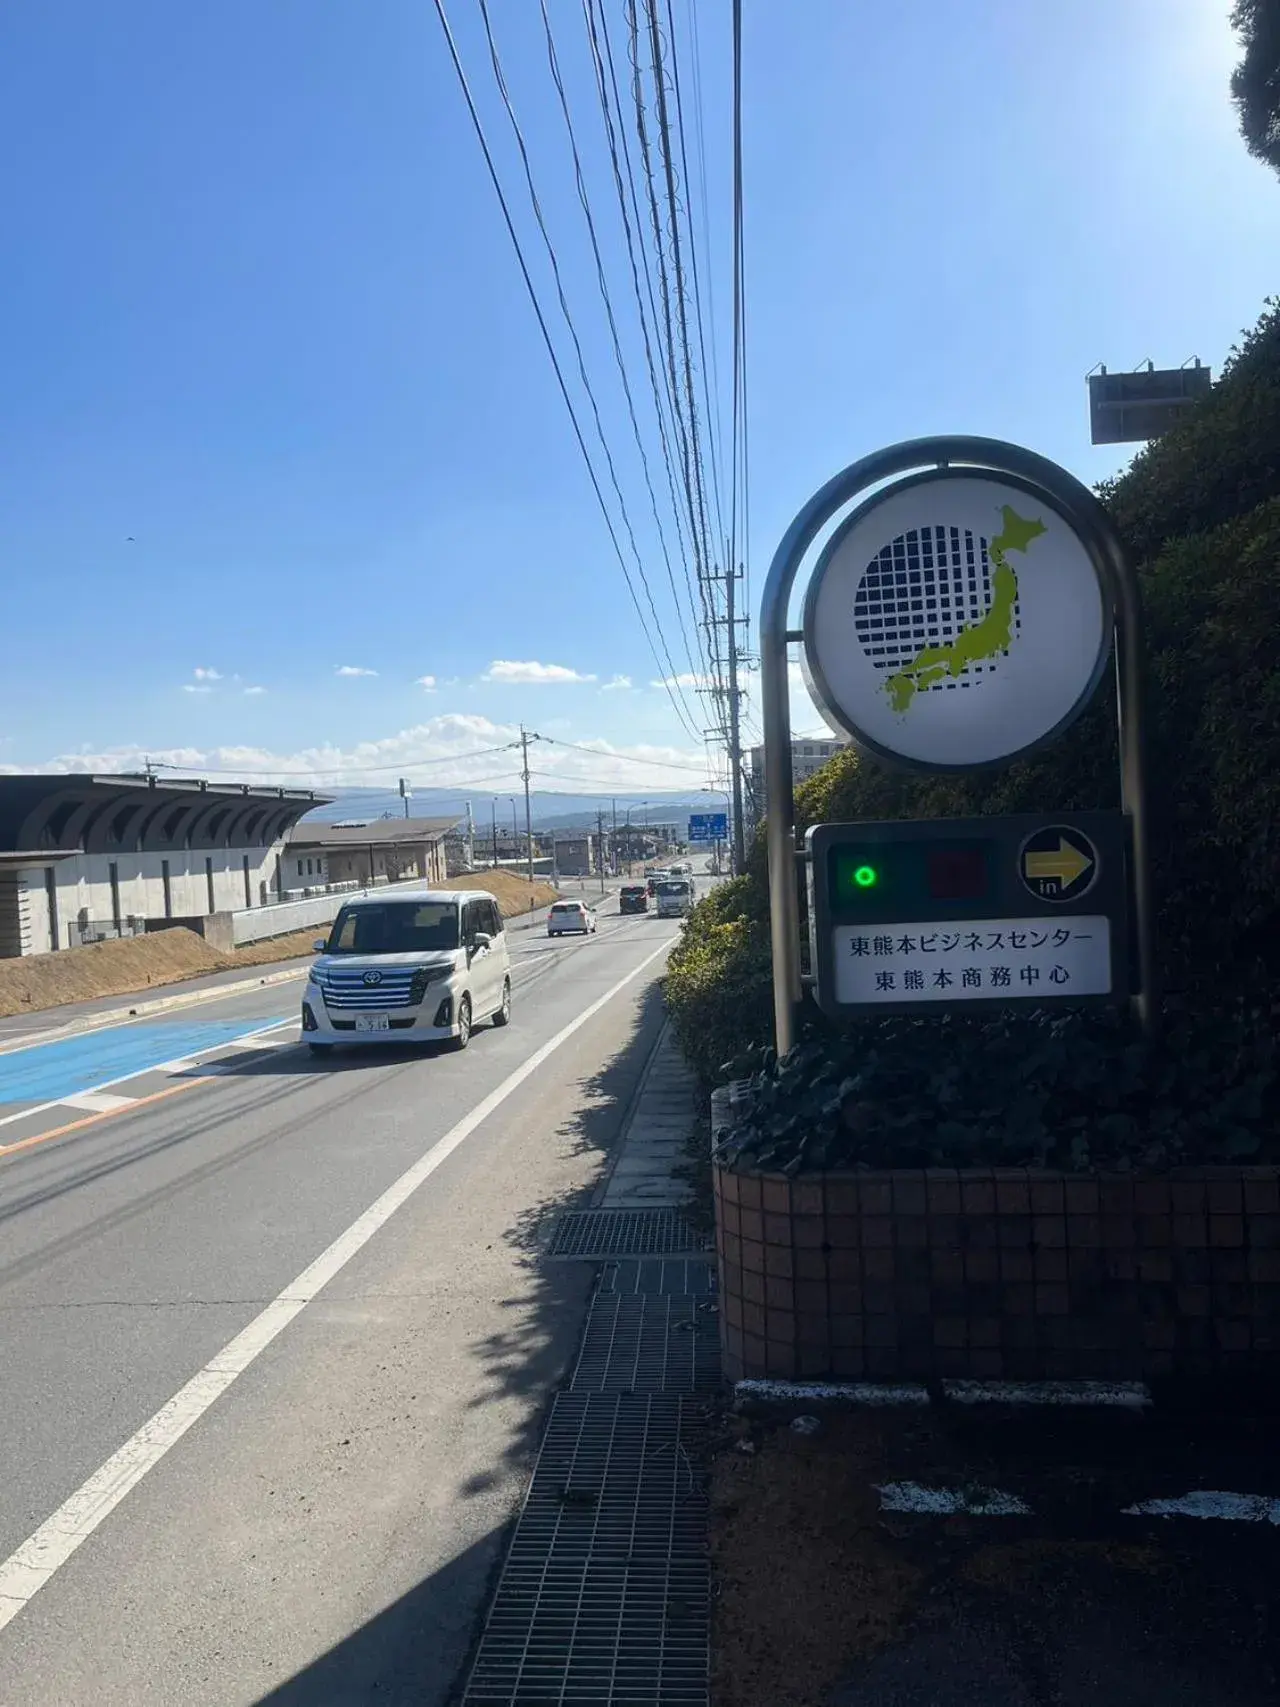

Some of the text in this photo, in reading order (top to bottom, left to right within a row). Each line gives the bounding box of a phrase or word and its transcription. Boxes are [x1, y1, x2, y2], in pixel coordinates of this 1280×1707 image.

[1040, 880, 1057, 894] in
[850, 928, 1093, 957] 東熊本ビジネスセンター
[875, 964, 1070, 991] 東熊本商務中心
